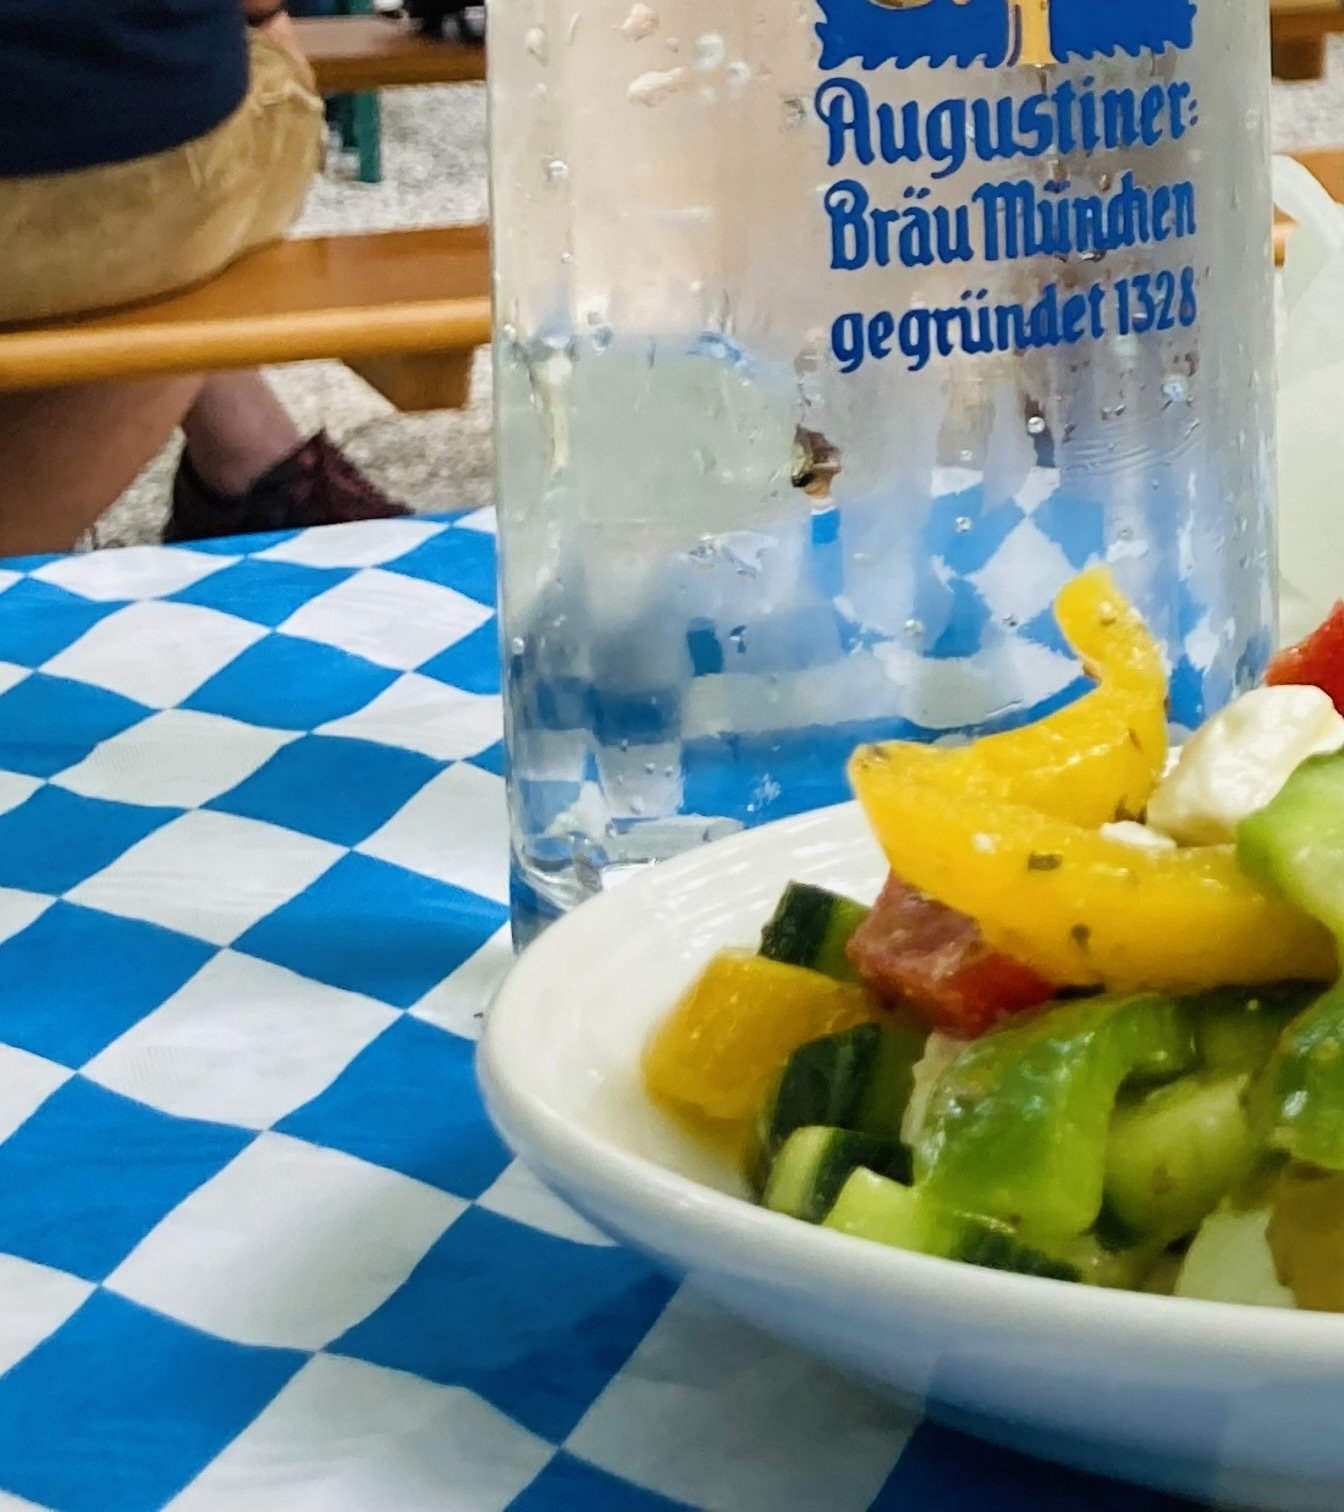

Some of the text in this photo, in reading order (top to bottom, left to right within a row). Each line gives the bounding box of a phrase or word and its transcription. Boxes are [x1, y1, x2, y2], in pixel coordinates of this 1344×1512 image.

[824, 169, 1198, 271] Bräu München
[830, 264, 1198, 375] gegründet 1328
